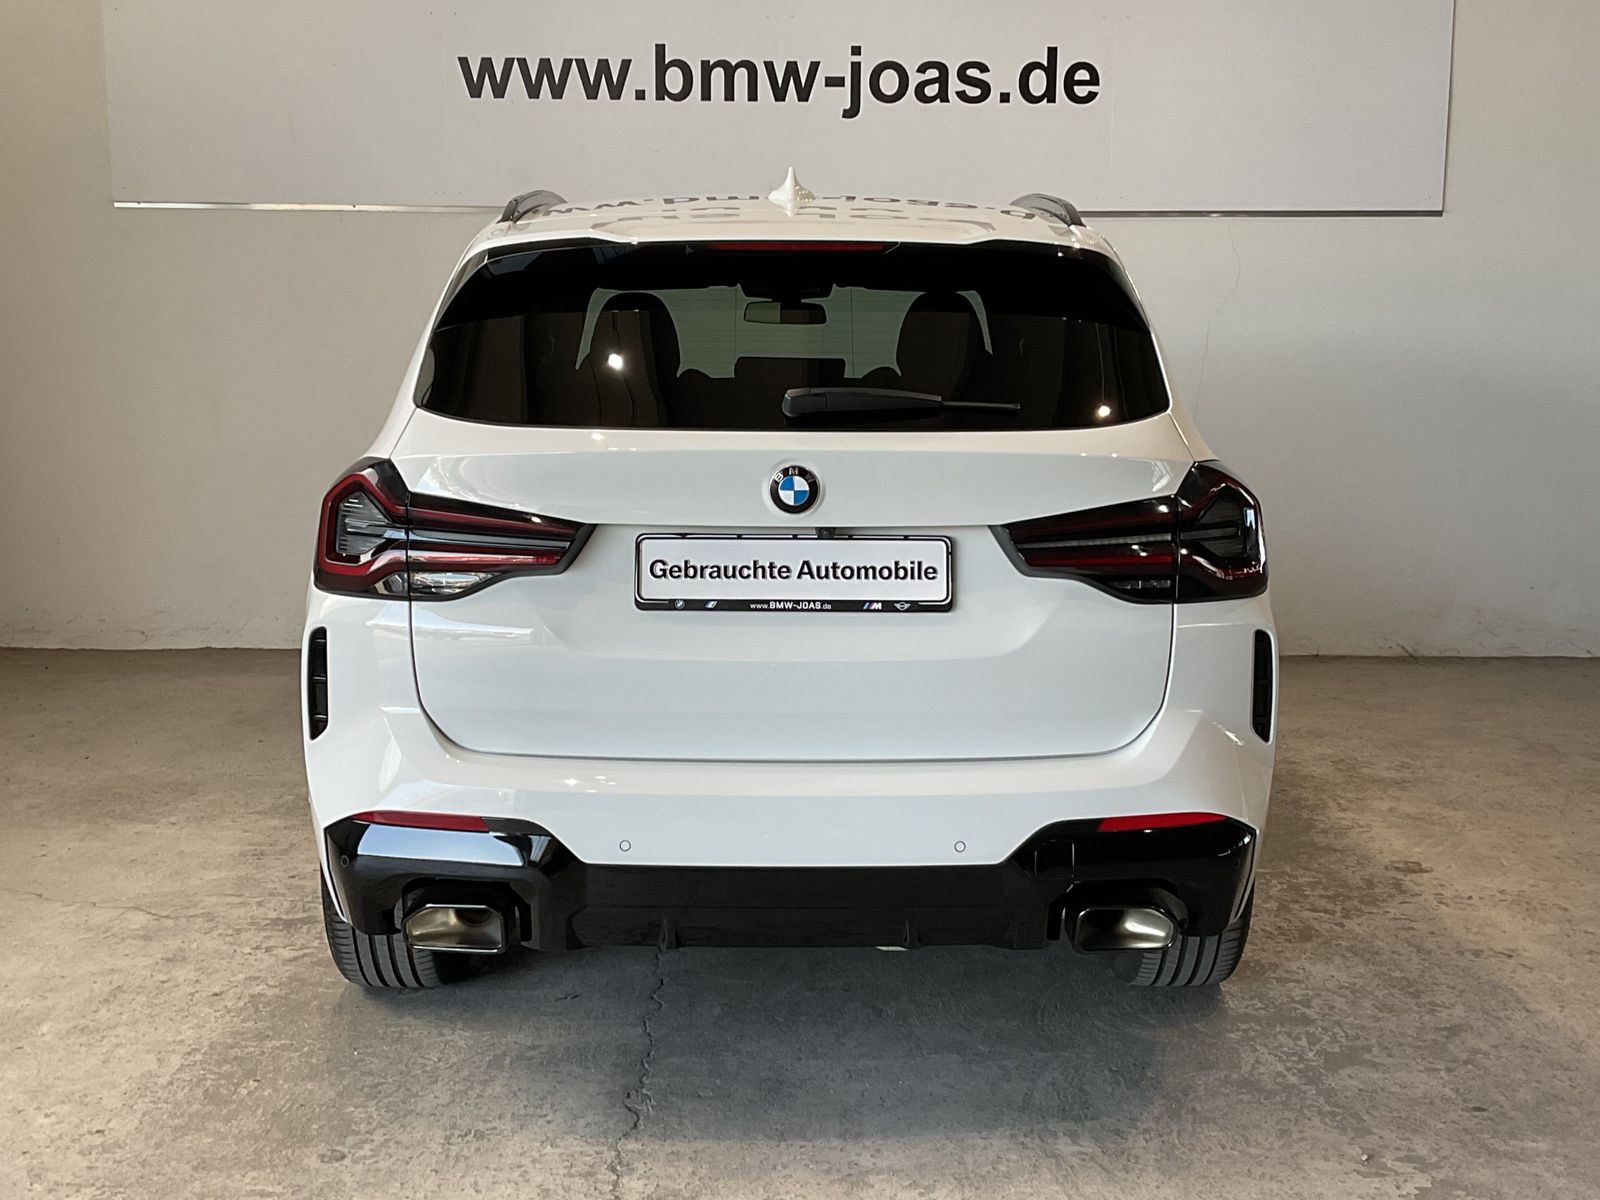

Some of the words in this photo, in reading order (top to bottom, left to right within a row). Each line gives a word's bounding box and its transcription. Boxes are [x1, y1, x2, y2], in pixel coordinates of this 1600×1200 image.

[457, 43, 1101, 119] www.bmw-joas.de
[774, 467, 815, 483] BMW
[649, 559, 791, 580] Gebrauchte
[796, 560, 938, 580] Automobile
